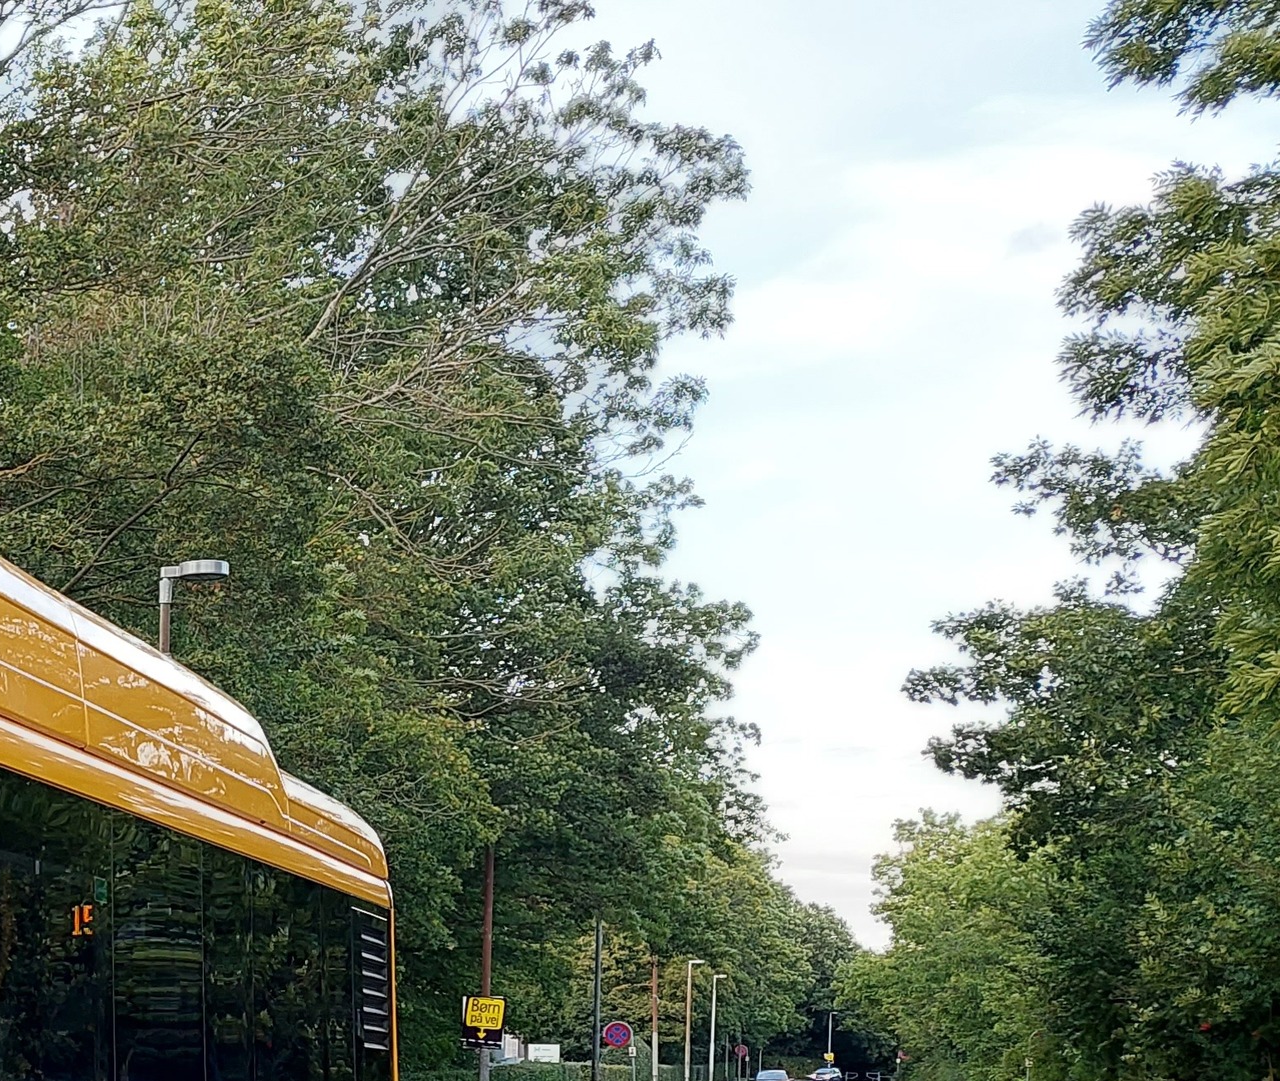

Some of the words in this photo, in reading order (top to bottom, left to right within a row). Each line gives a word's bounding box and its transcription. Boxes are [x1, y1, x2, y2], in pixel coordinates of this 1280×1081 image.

[471, 998, 500, 1014] Børn
[470, 1013, 483, 1025] på
[486, 1015, 500, 1028] vej
